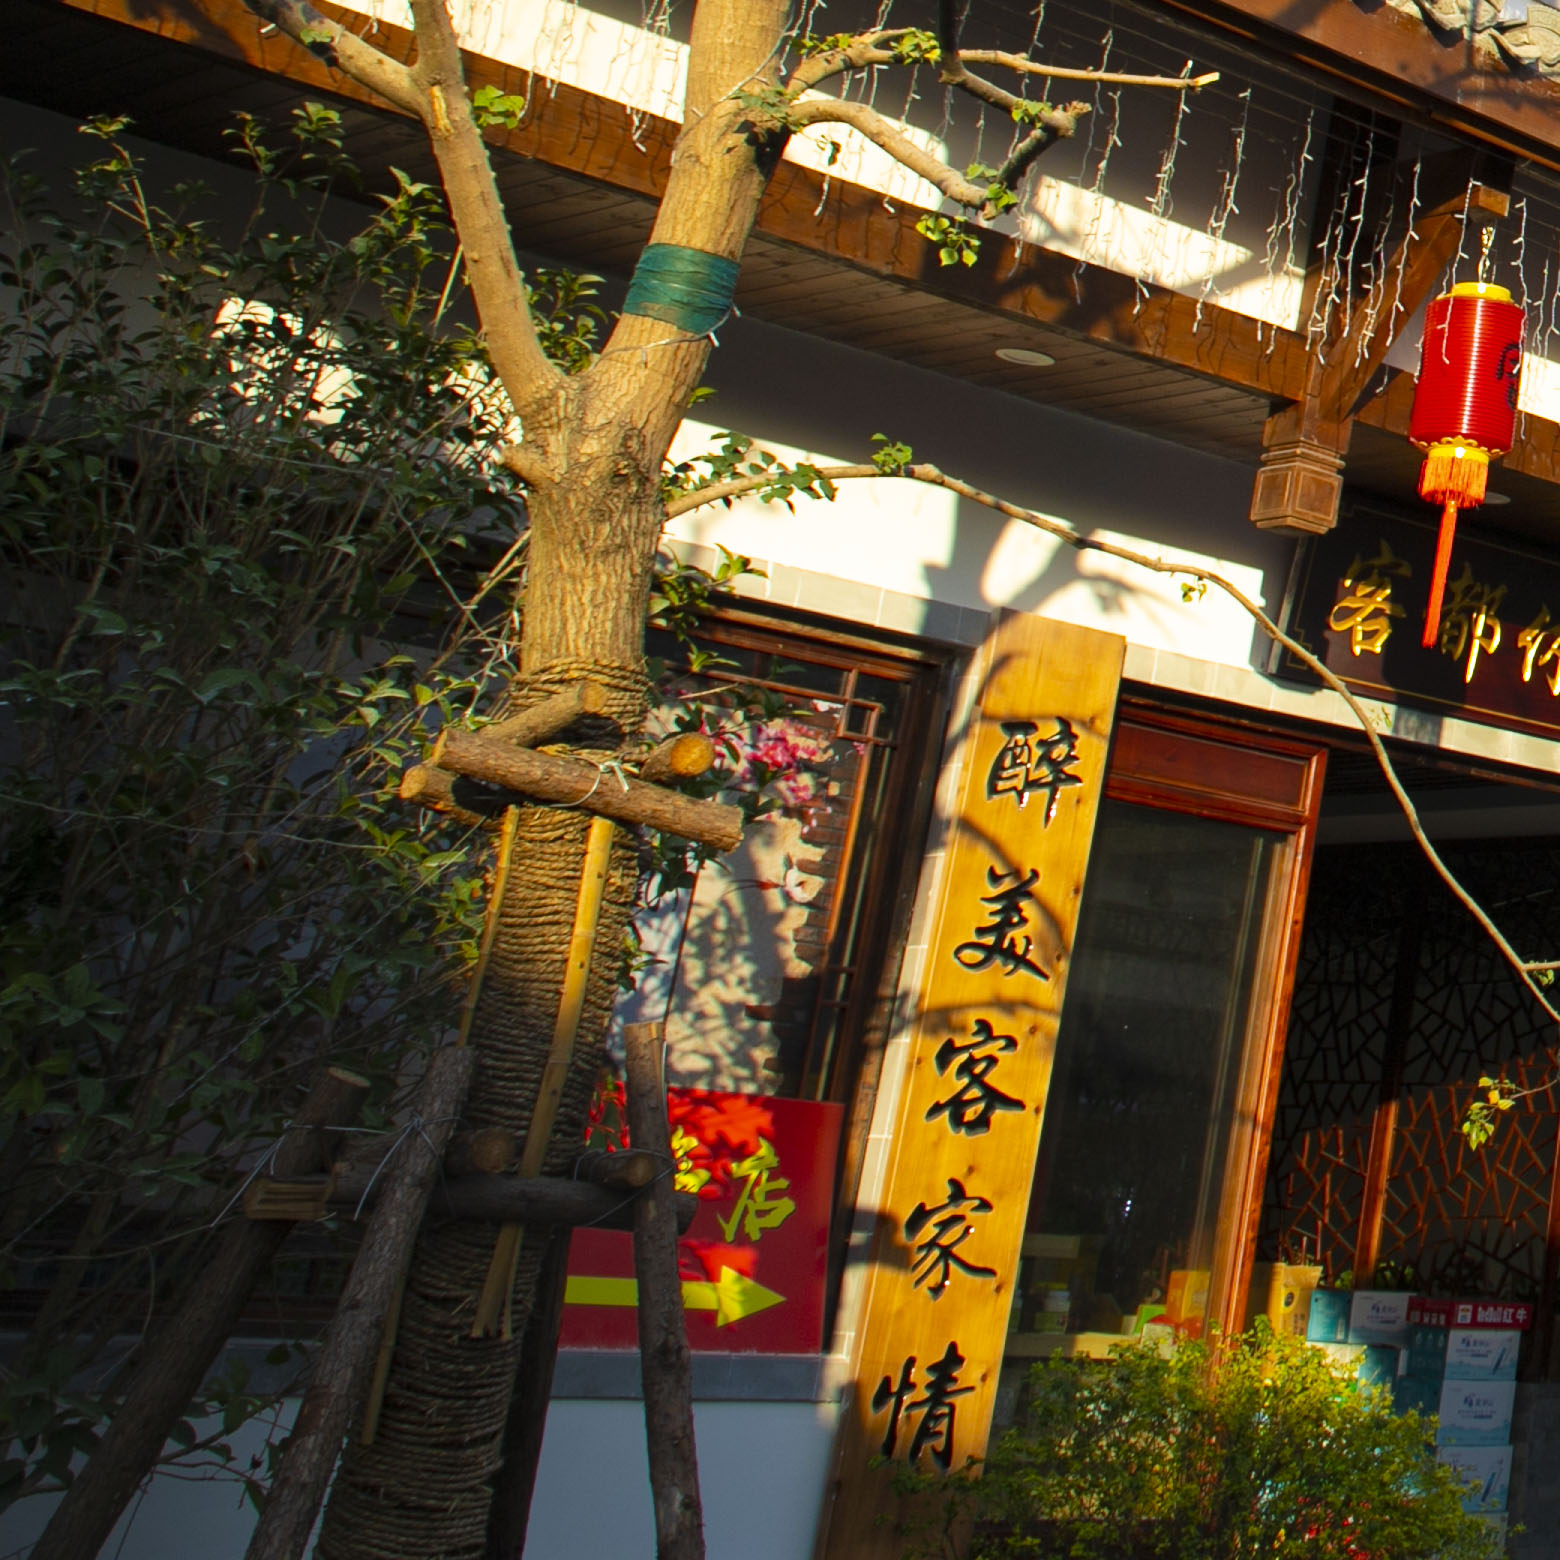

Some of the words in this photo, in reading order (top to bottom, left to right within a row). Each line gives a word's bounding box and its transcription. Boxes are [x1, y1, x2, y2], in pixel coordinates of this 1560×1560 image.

[871, 717, 1083, 1471] 醉美客家情
